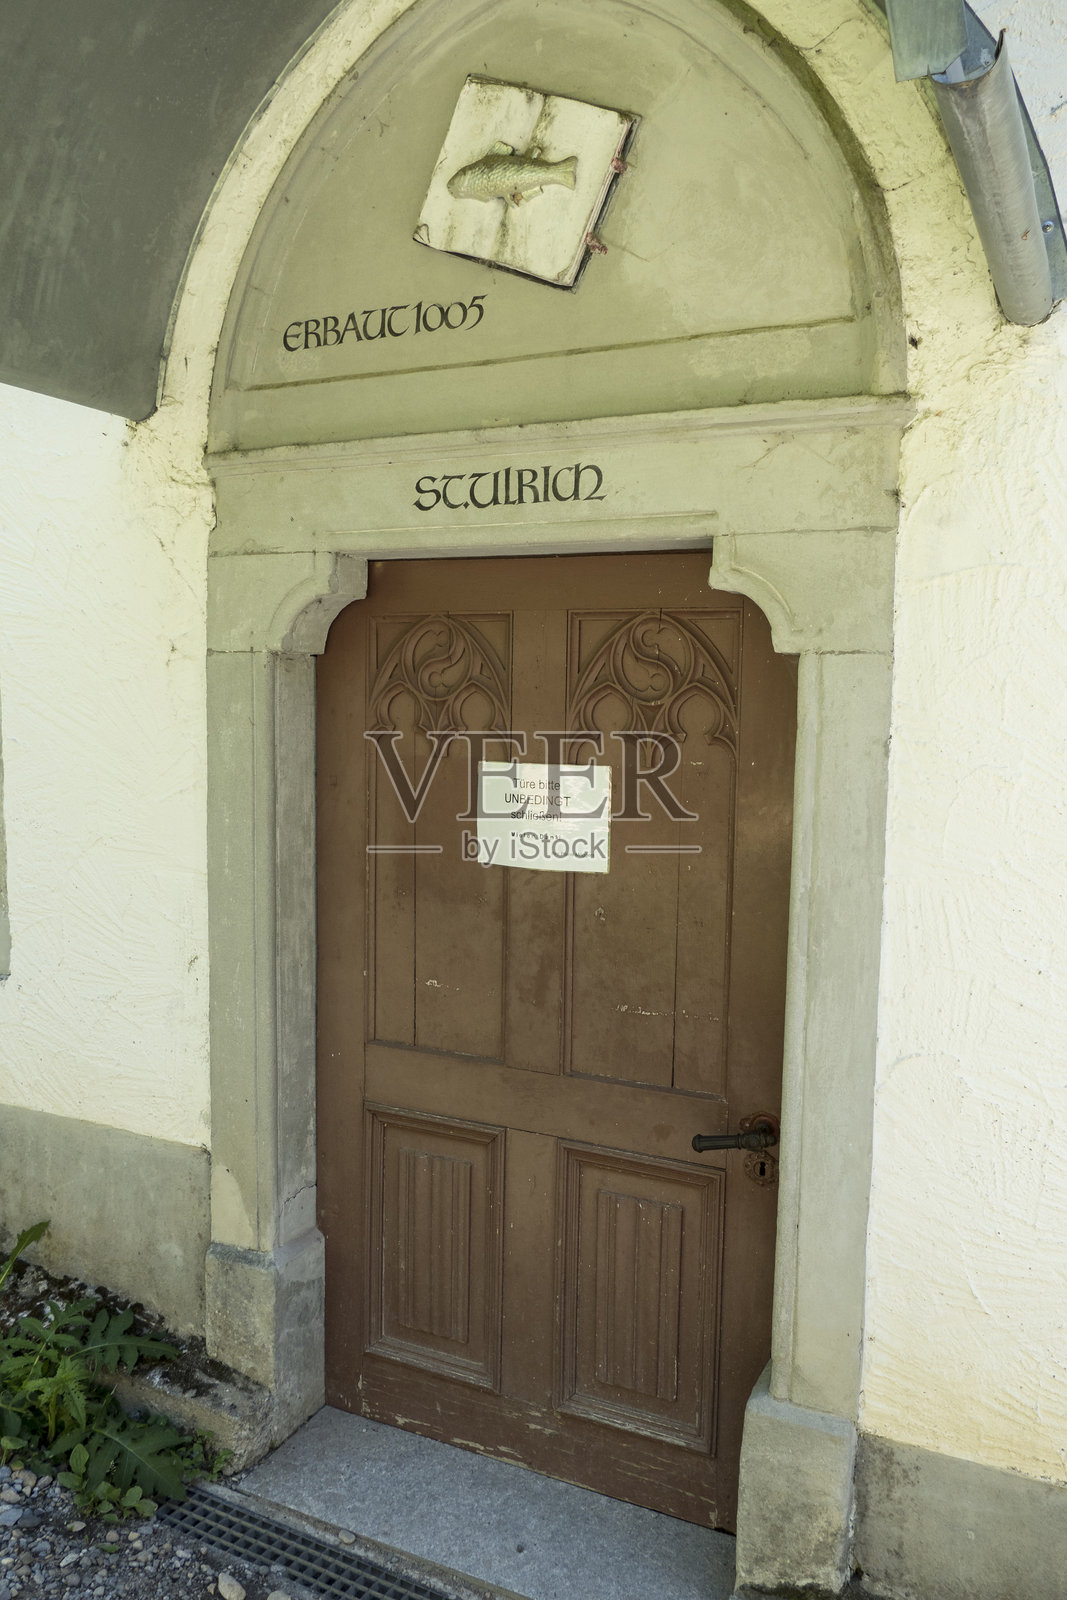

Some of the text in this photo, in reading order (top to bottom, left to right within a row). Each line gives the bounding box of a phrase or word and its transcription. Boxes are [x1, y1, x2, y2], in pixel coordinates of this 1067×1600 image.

[283, 294, 488, 352] ERBAUT 1005
[513, 778, 560, 791] Türe bitte
[504, 793, 571, 807] UNBEDINGT
[510, 810, 562, 822] schließen!
